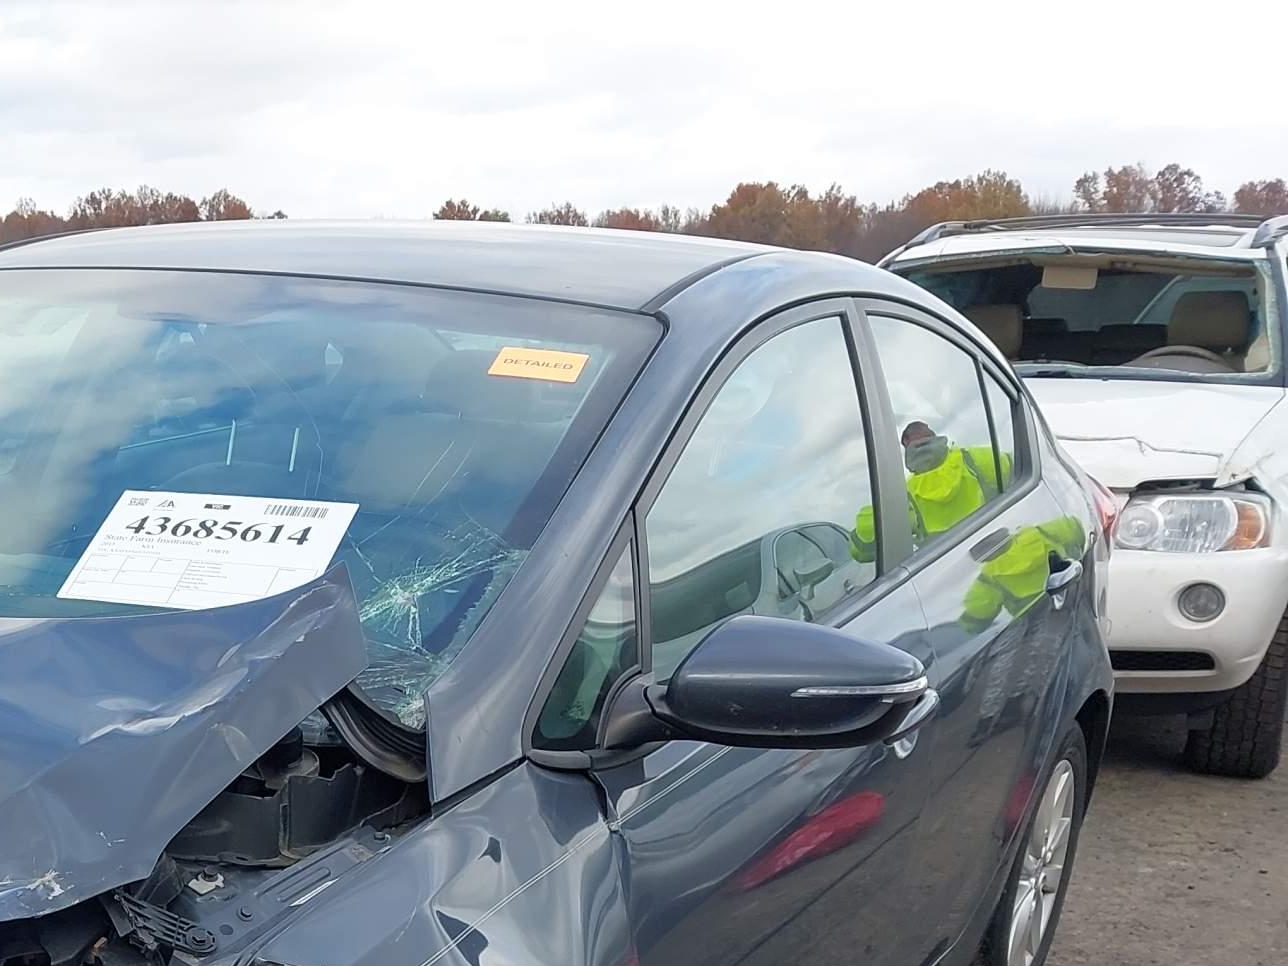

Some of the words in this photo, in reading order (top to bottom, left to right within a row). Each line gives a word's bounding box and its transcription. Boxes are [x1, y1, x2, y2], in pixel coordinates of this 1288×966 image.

[503, 358, 574, 370] DETAILED
[125, 515, 313, 546] 43685614
[129, 535, 155, 543] Farm
[157, 537, 202, 546] Insurance
